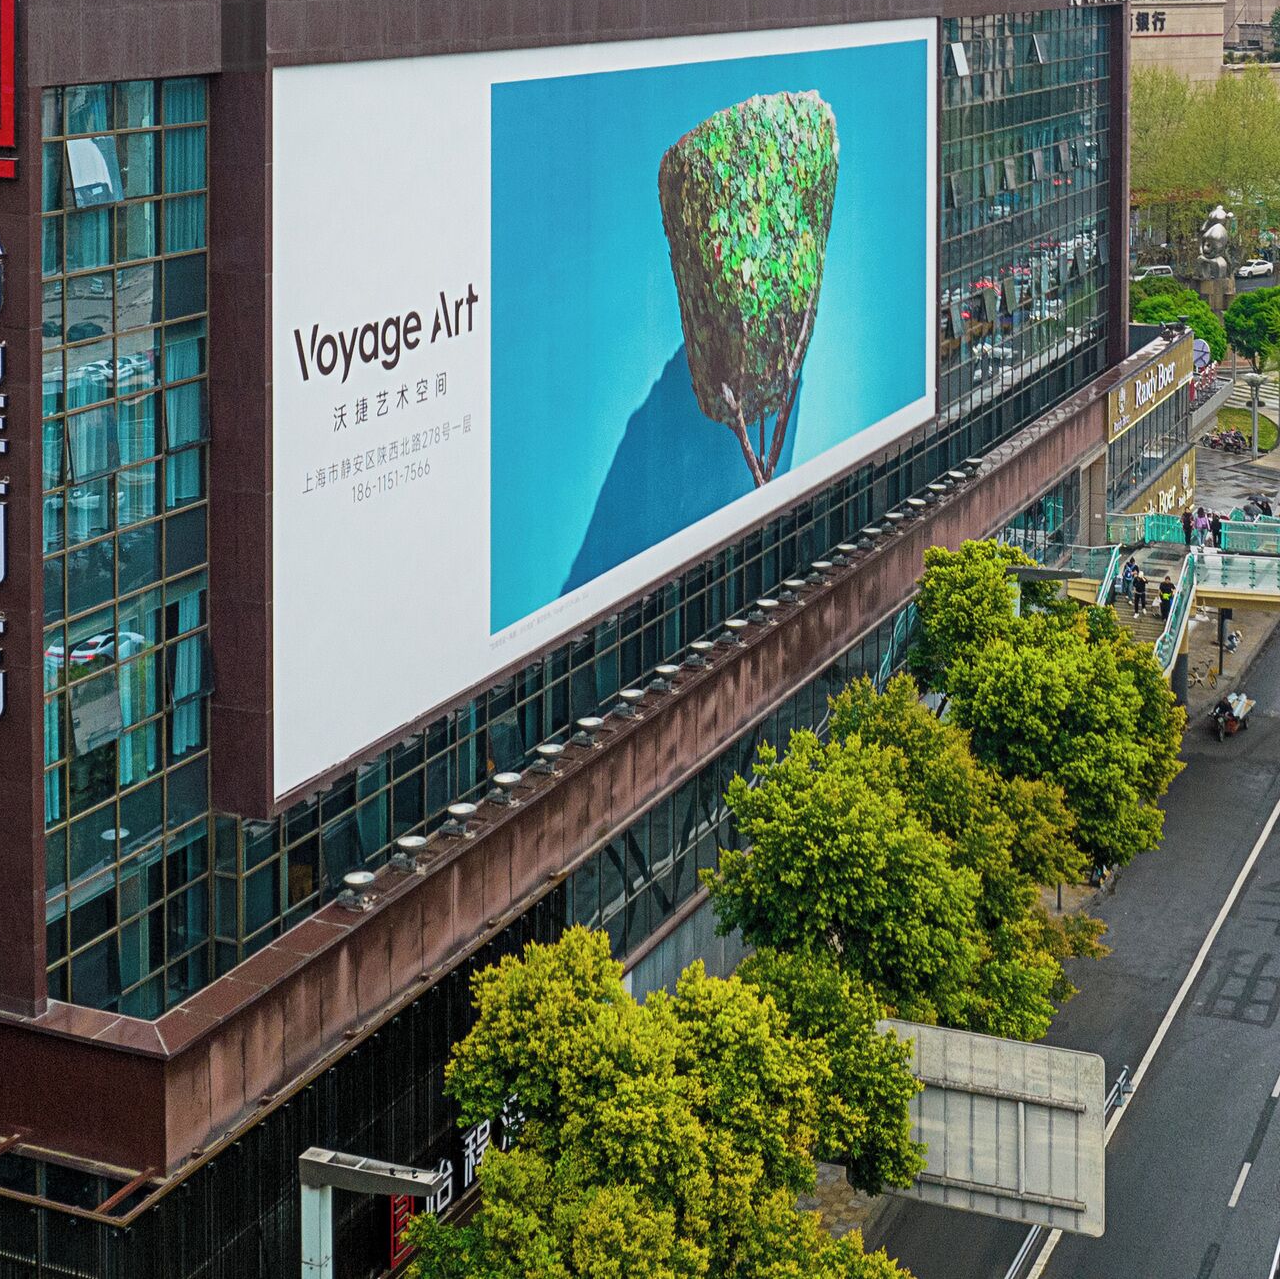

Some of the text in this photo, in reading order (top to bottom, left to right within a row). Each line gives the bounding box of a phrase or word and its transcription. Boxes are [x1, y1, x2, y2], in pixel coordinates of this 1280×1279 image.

[293, 283, 479, 385] Voyage Art
[333, 371, 447, 433] 沃捷艺术空间
[1157, 361, 1176, 393] Boer
[351, 457, 431, 504] 186-1151-7566
